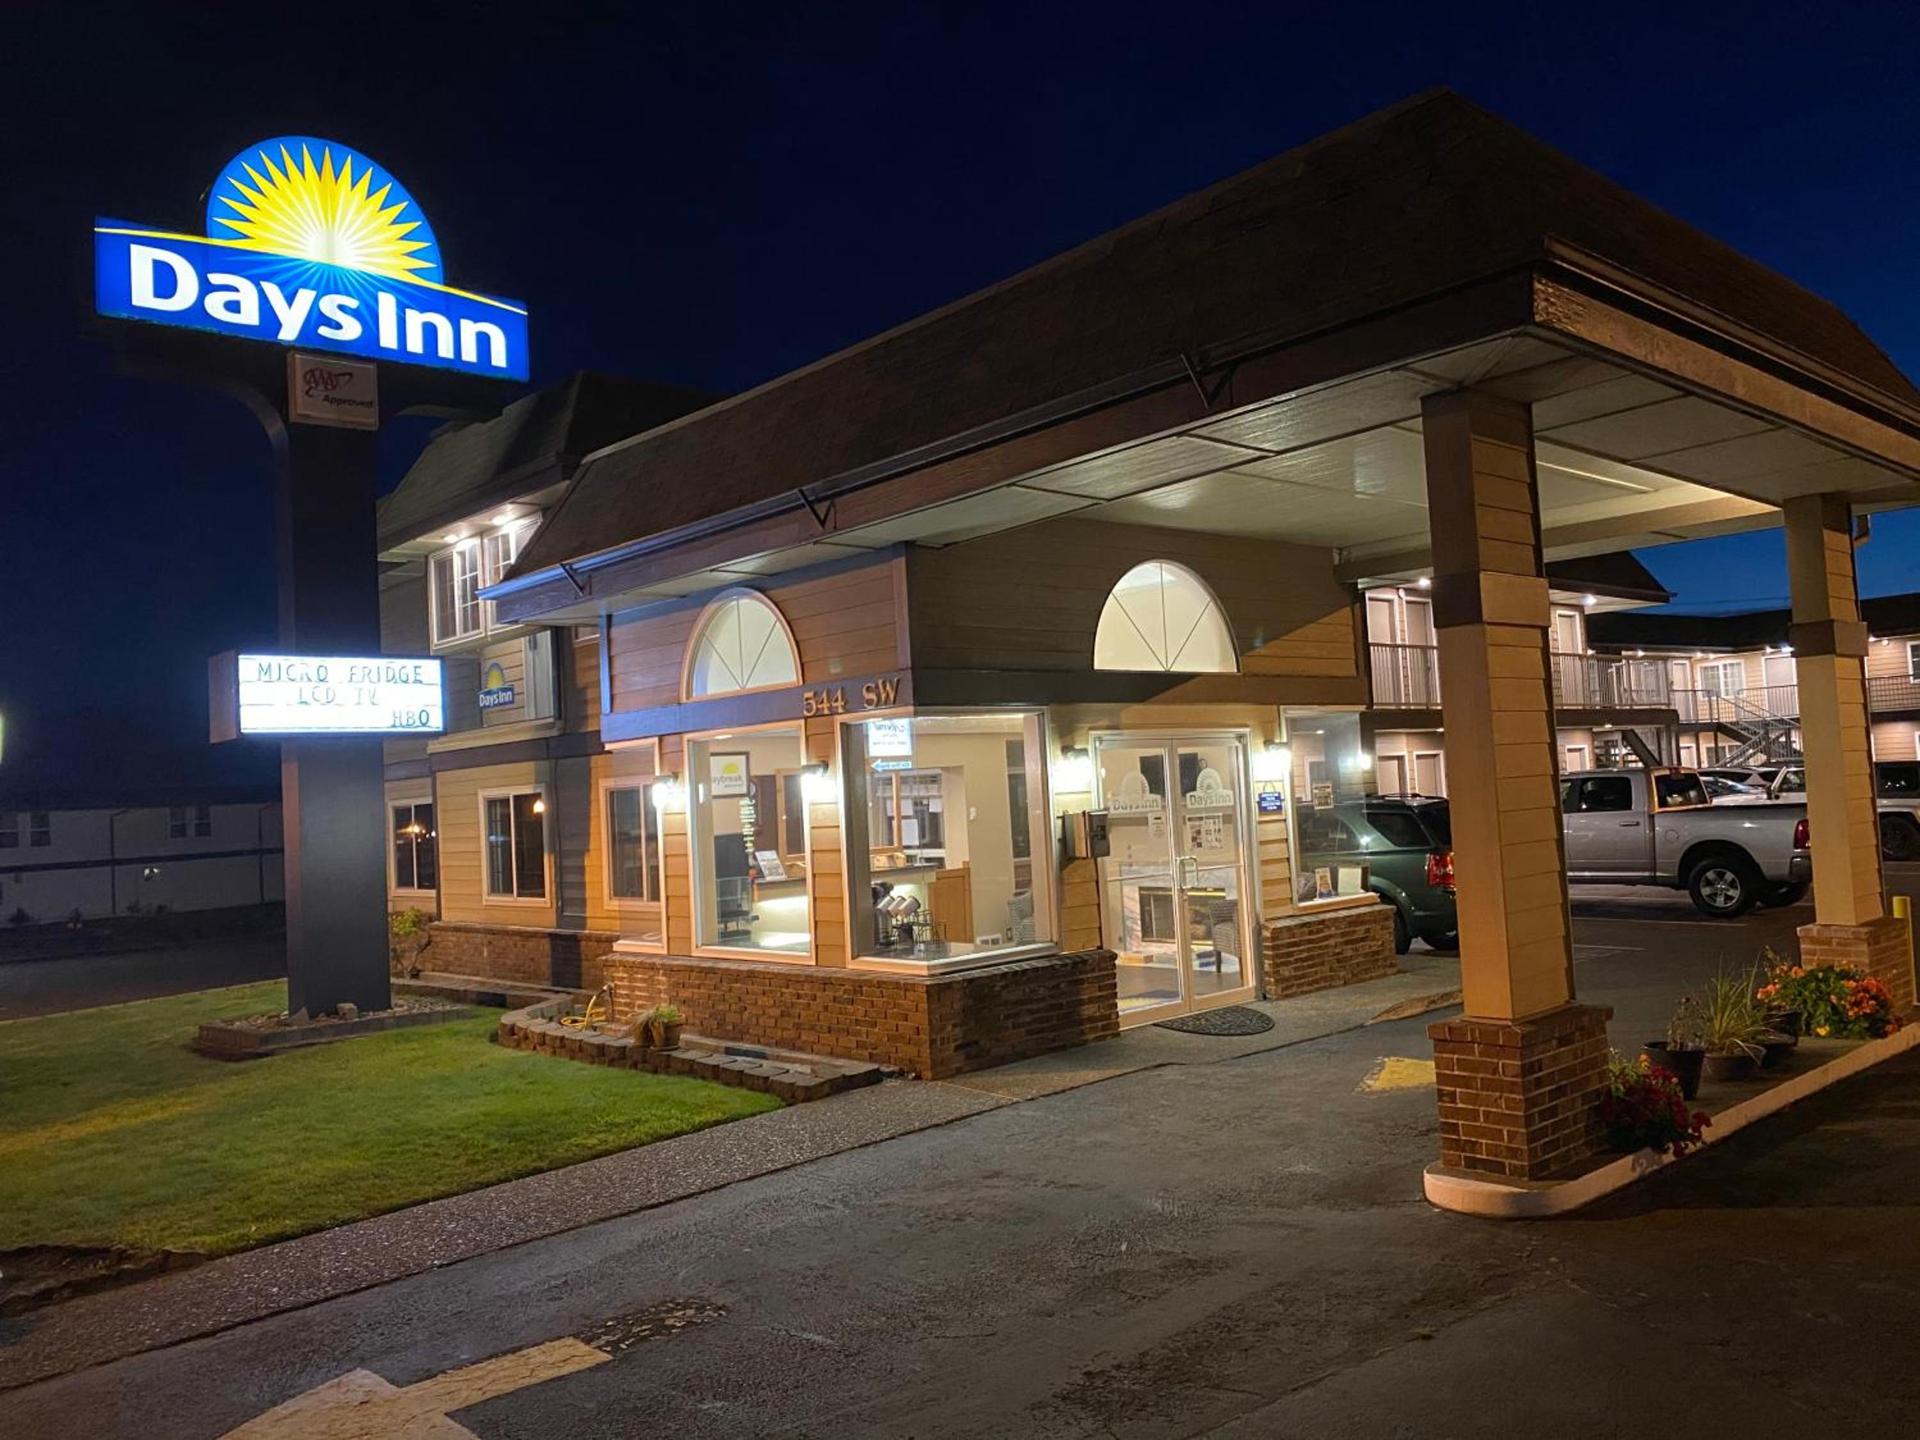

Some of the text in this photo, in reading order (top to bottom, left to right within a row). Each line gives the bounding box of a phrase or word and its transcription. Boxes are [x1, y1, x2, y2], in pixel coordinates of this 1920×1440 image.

[129, 243, 508, 368] Days Inn
[322, 394, 374, 409] Approved
[257, 662, 424, 684] MICRO FRIDGE
[297, 685, 336, 705] LCD
[479, 690, 513, 707] Days Inn
[803, 677, 901, 717] 544 SW
[391, 709, 431, 729] HBO
[1189, 792, 1232, 807] Days Inn
